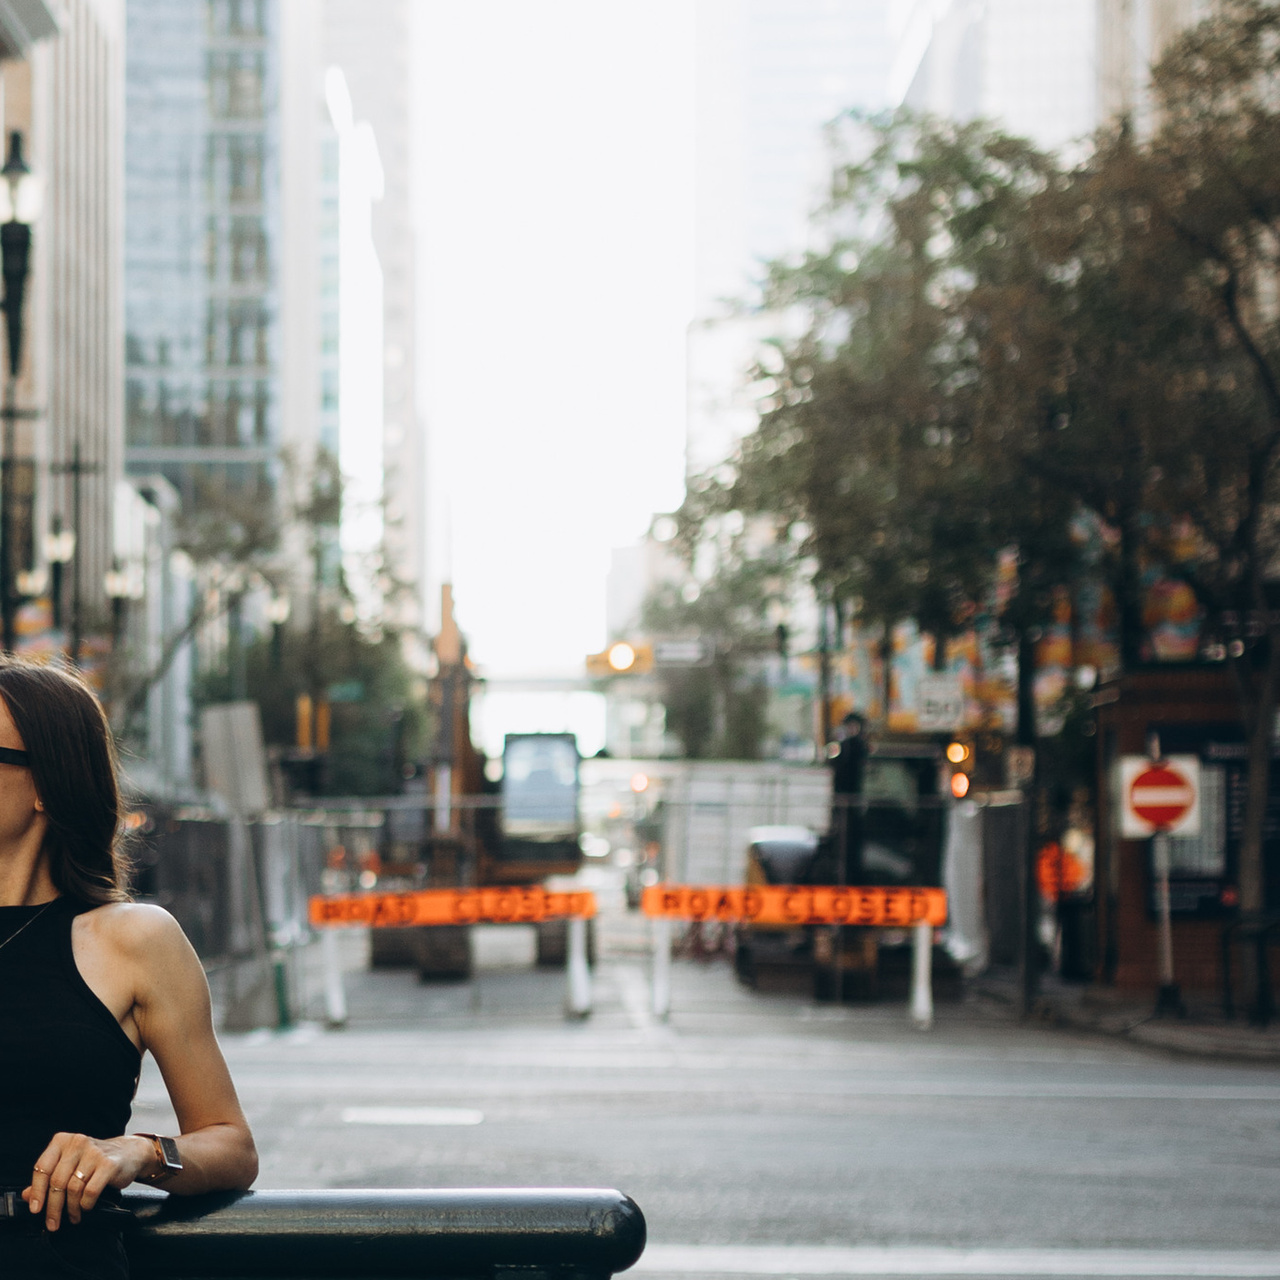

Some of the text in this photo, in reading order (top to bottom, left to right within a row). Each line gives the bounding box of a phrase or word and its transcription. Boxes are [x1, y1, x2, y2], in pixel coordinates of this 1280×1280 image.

[321, 890, 587, 926] ROAD CLOSED
[661, 888, 930, 924] ROAD CLOSED
